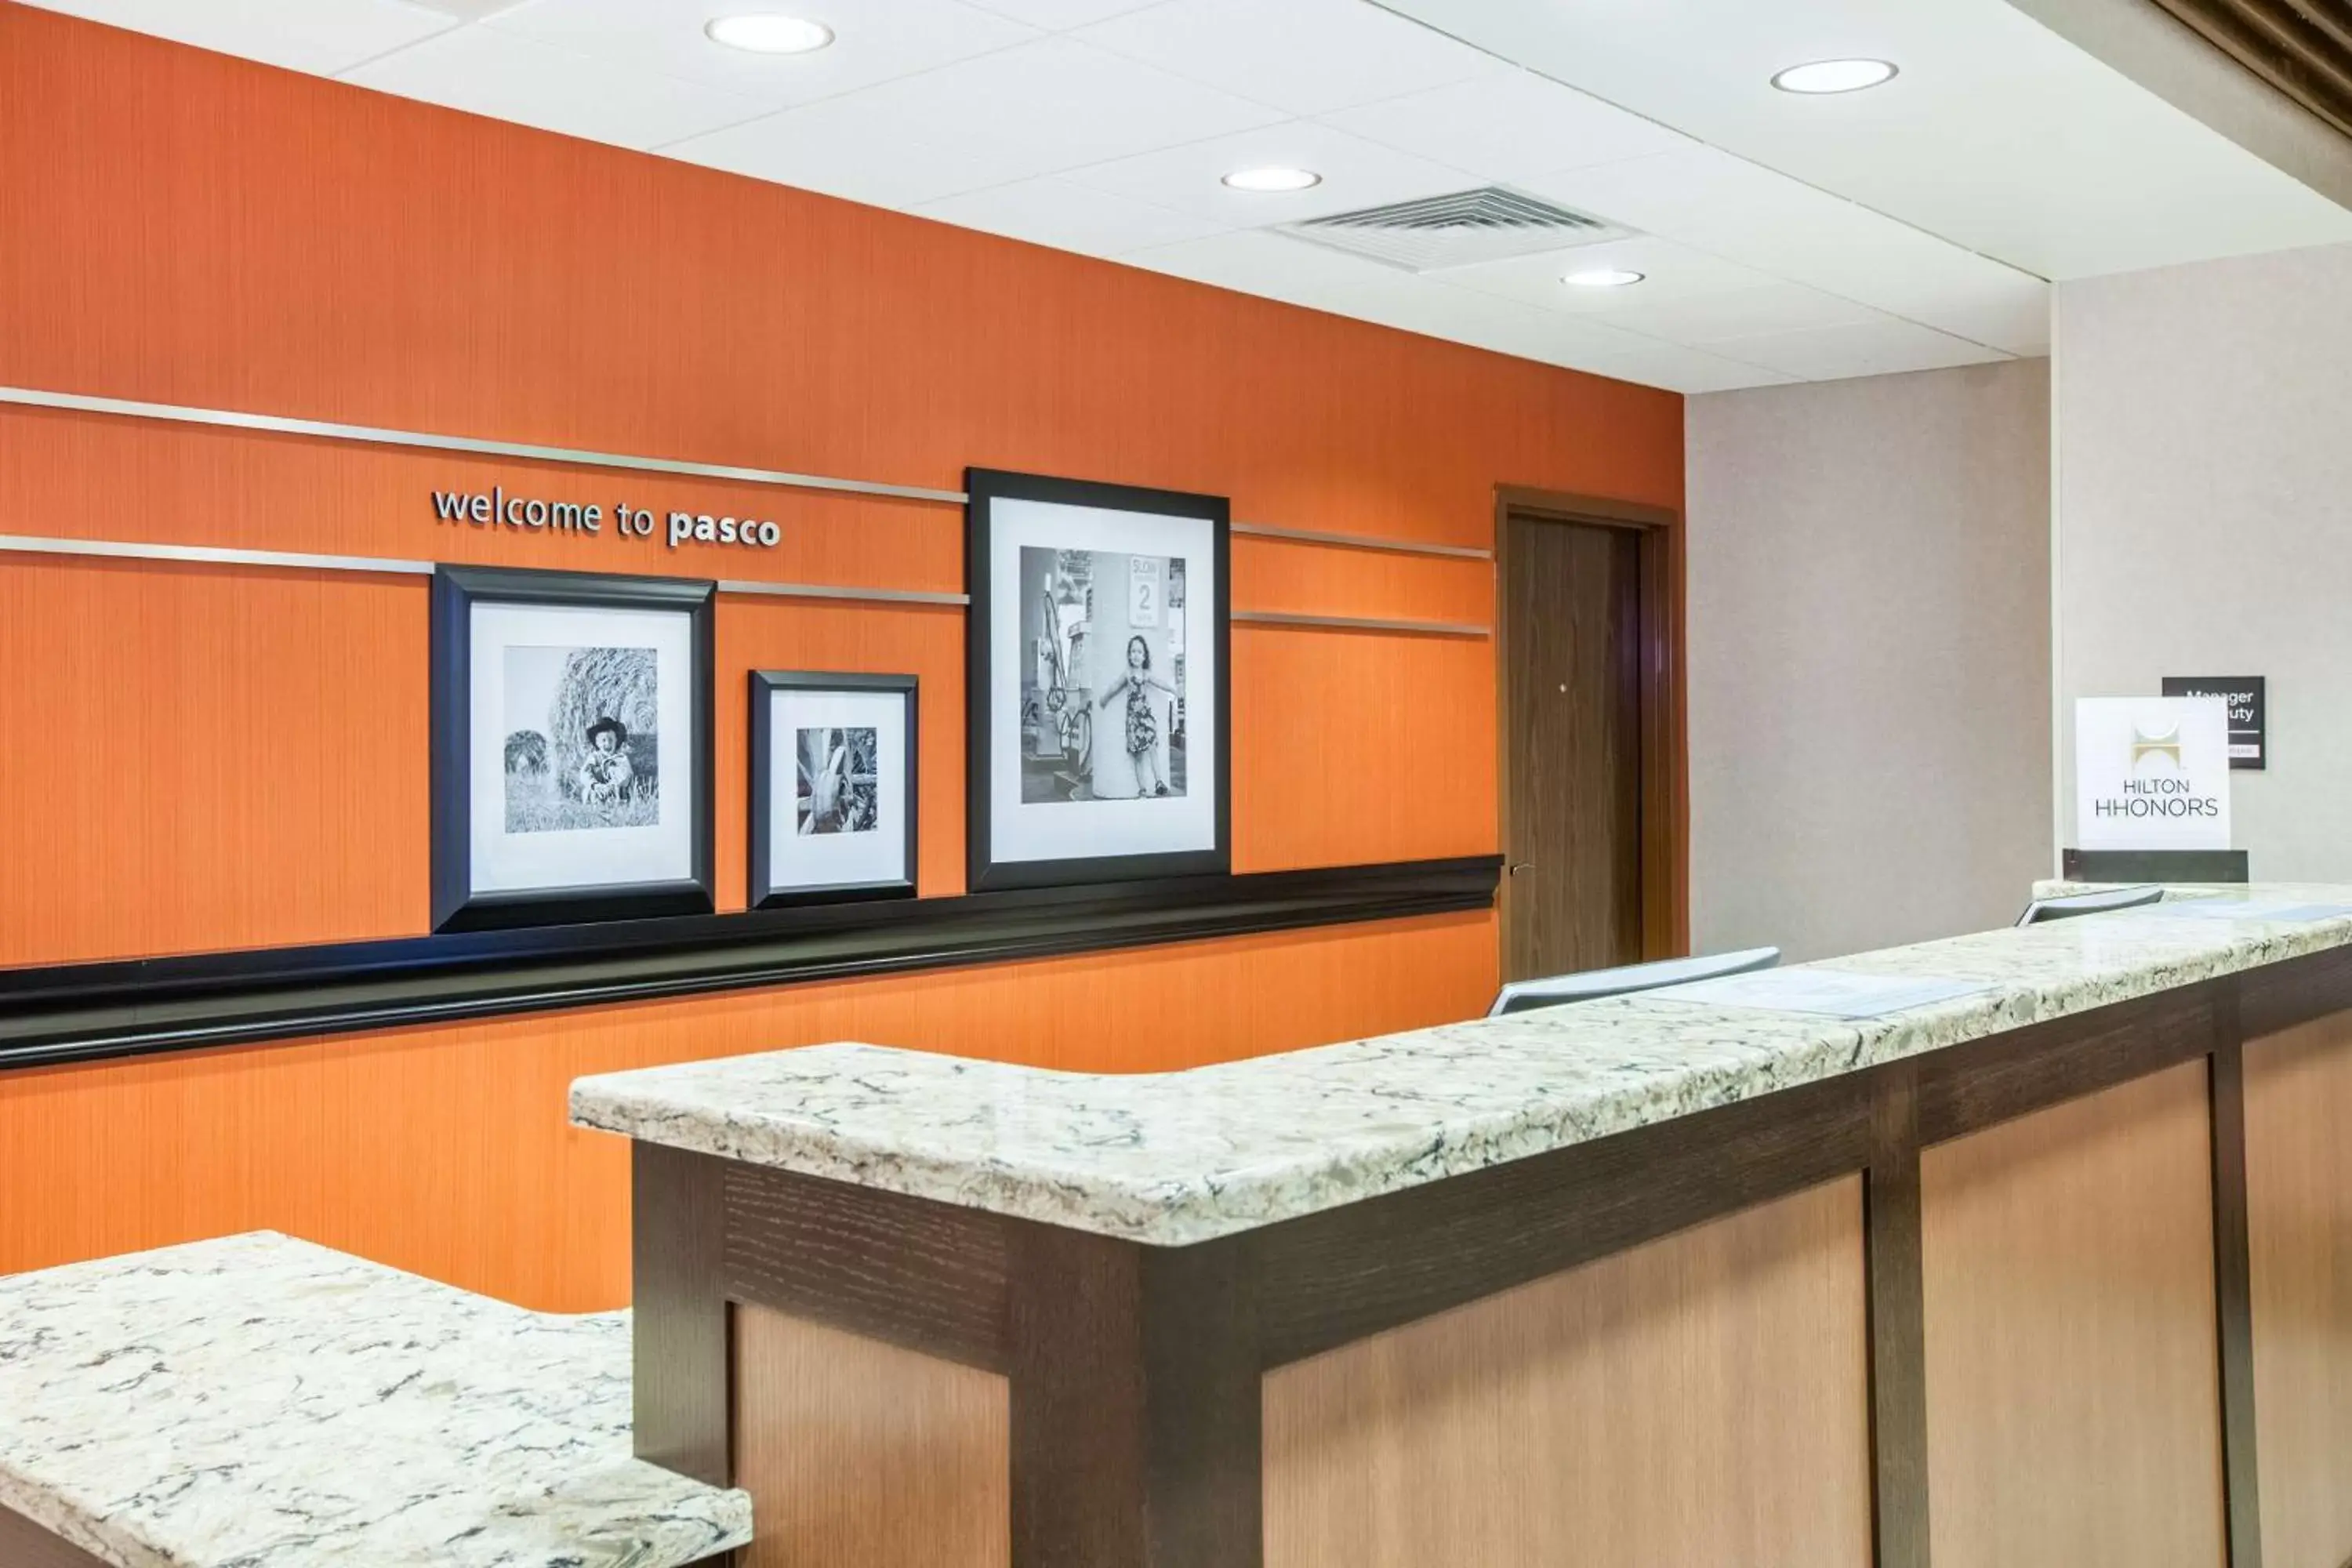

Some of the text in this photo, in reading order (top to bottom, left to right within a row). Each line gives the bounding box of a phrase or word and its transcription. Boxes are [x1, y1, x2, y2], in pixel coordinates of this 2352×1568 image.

[434, 485, 781, 546] welcome to pasco
[1139, 584, 1151, 610] 2
[2228, 708, 2254, 721] uty
[2124, 779, 2190, 794] HILTON
[2095, 797, 2219, 817] HHONORS
